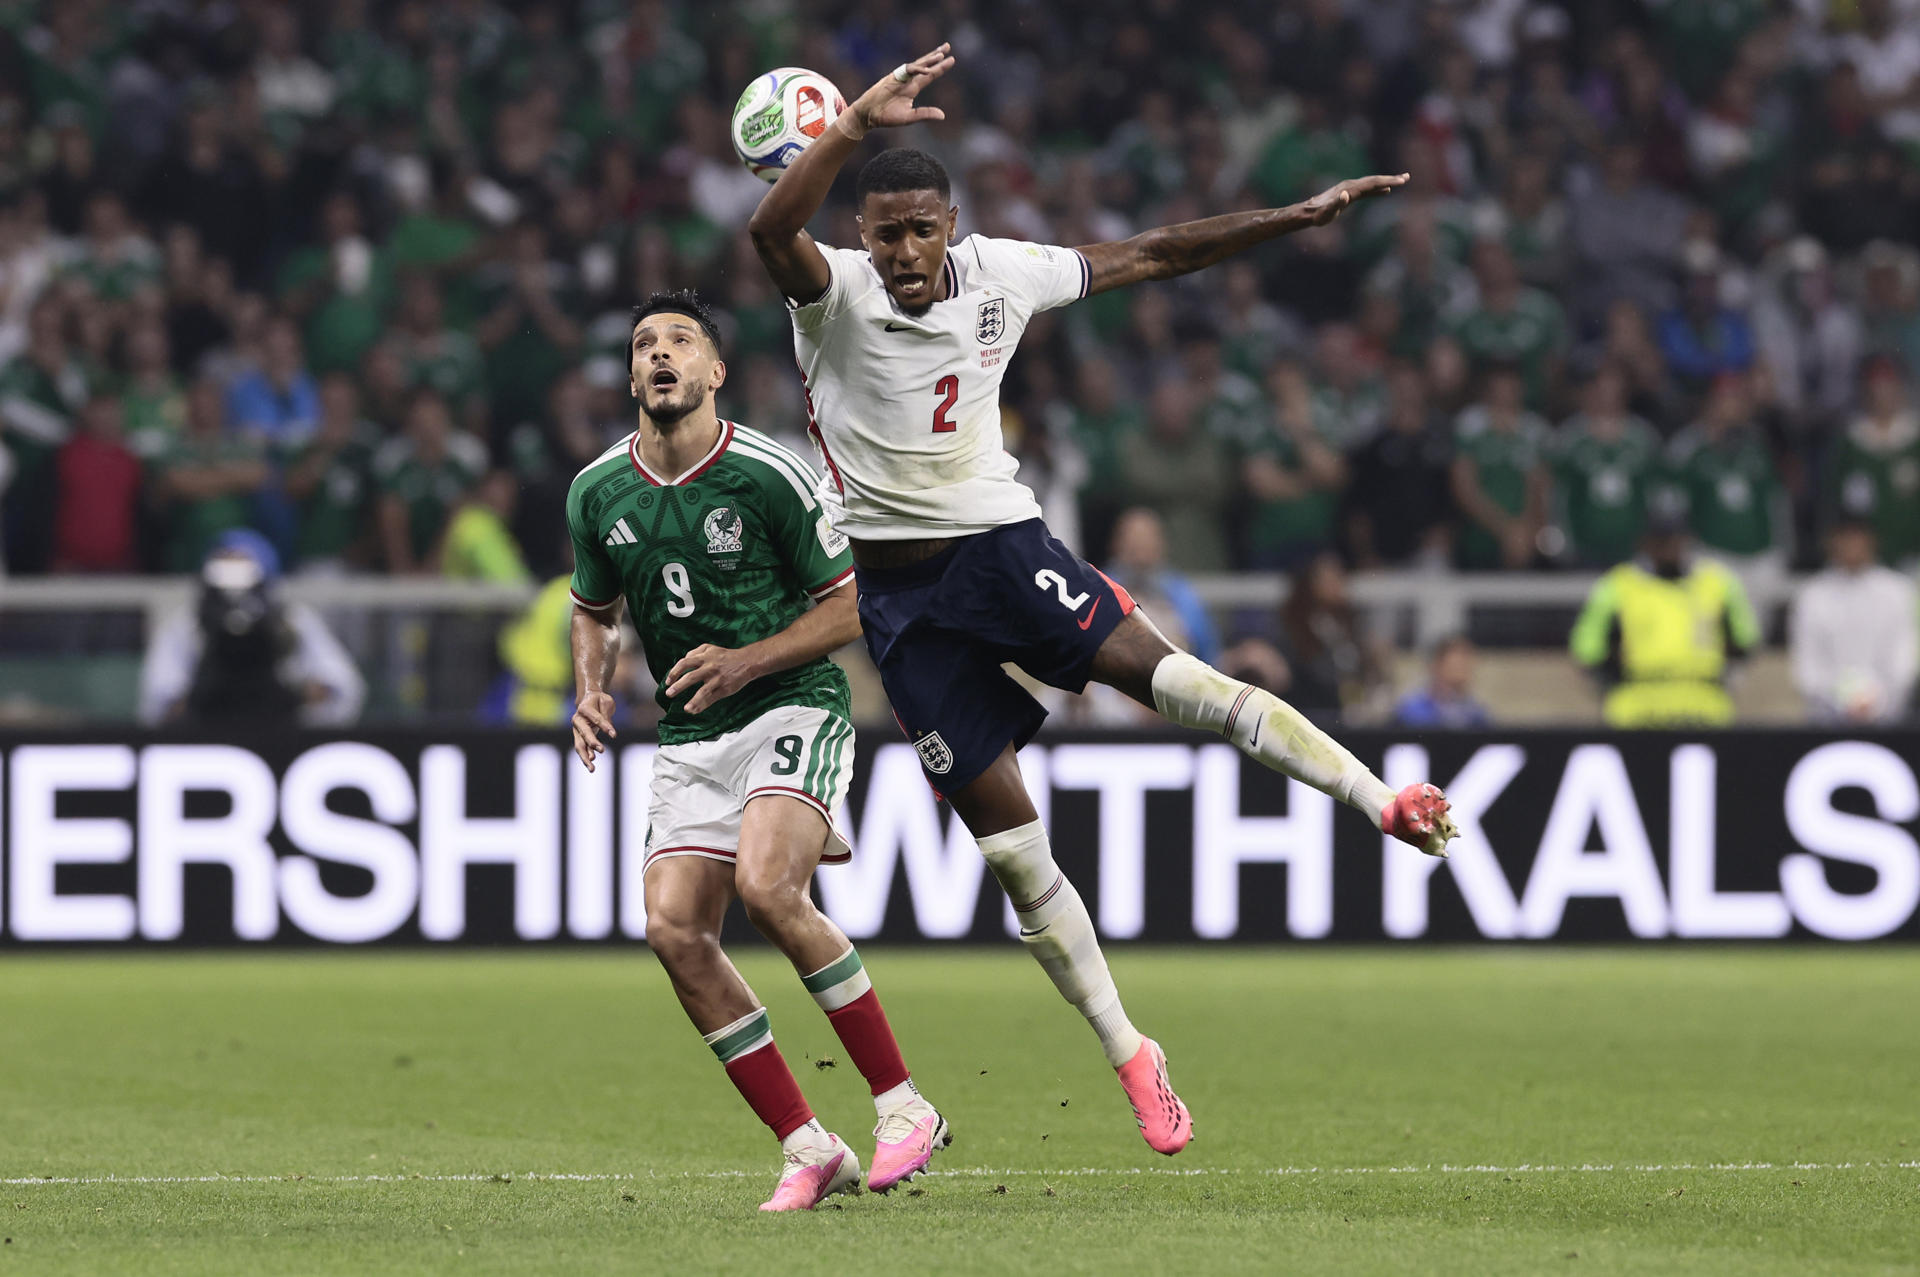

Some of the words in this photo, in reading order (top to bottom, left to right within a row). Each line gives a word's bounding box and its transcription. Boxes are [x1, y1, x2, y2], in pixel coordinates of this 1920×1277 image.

[980, 347, 1002, 358] MEXICO
[932, 374, 959, 433] 2
[708, 543, 742, 552] MEXICO
[662, 562, 696, 619] 9
[1035, 569, 1091, 612] 2
[770, 735, 803, 776] 9
[0, 741, 647, 944] ERSHI
[1382, 741, 1920, 943] KALS
